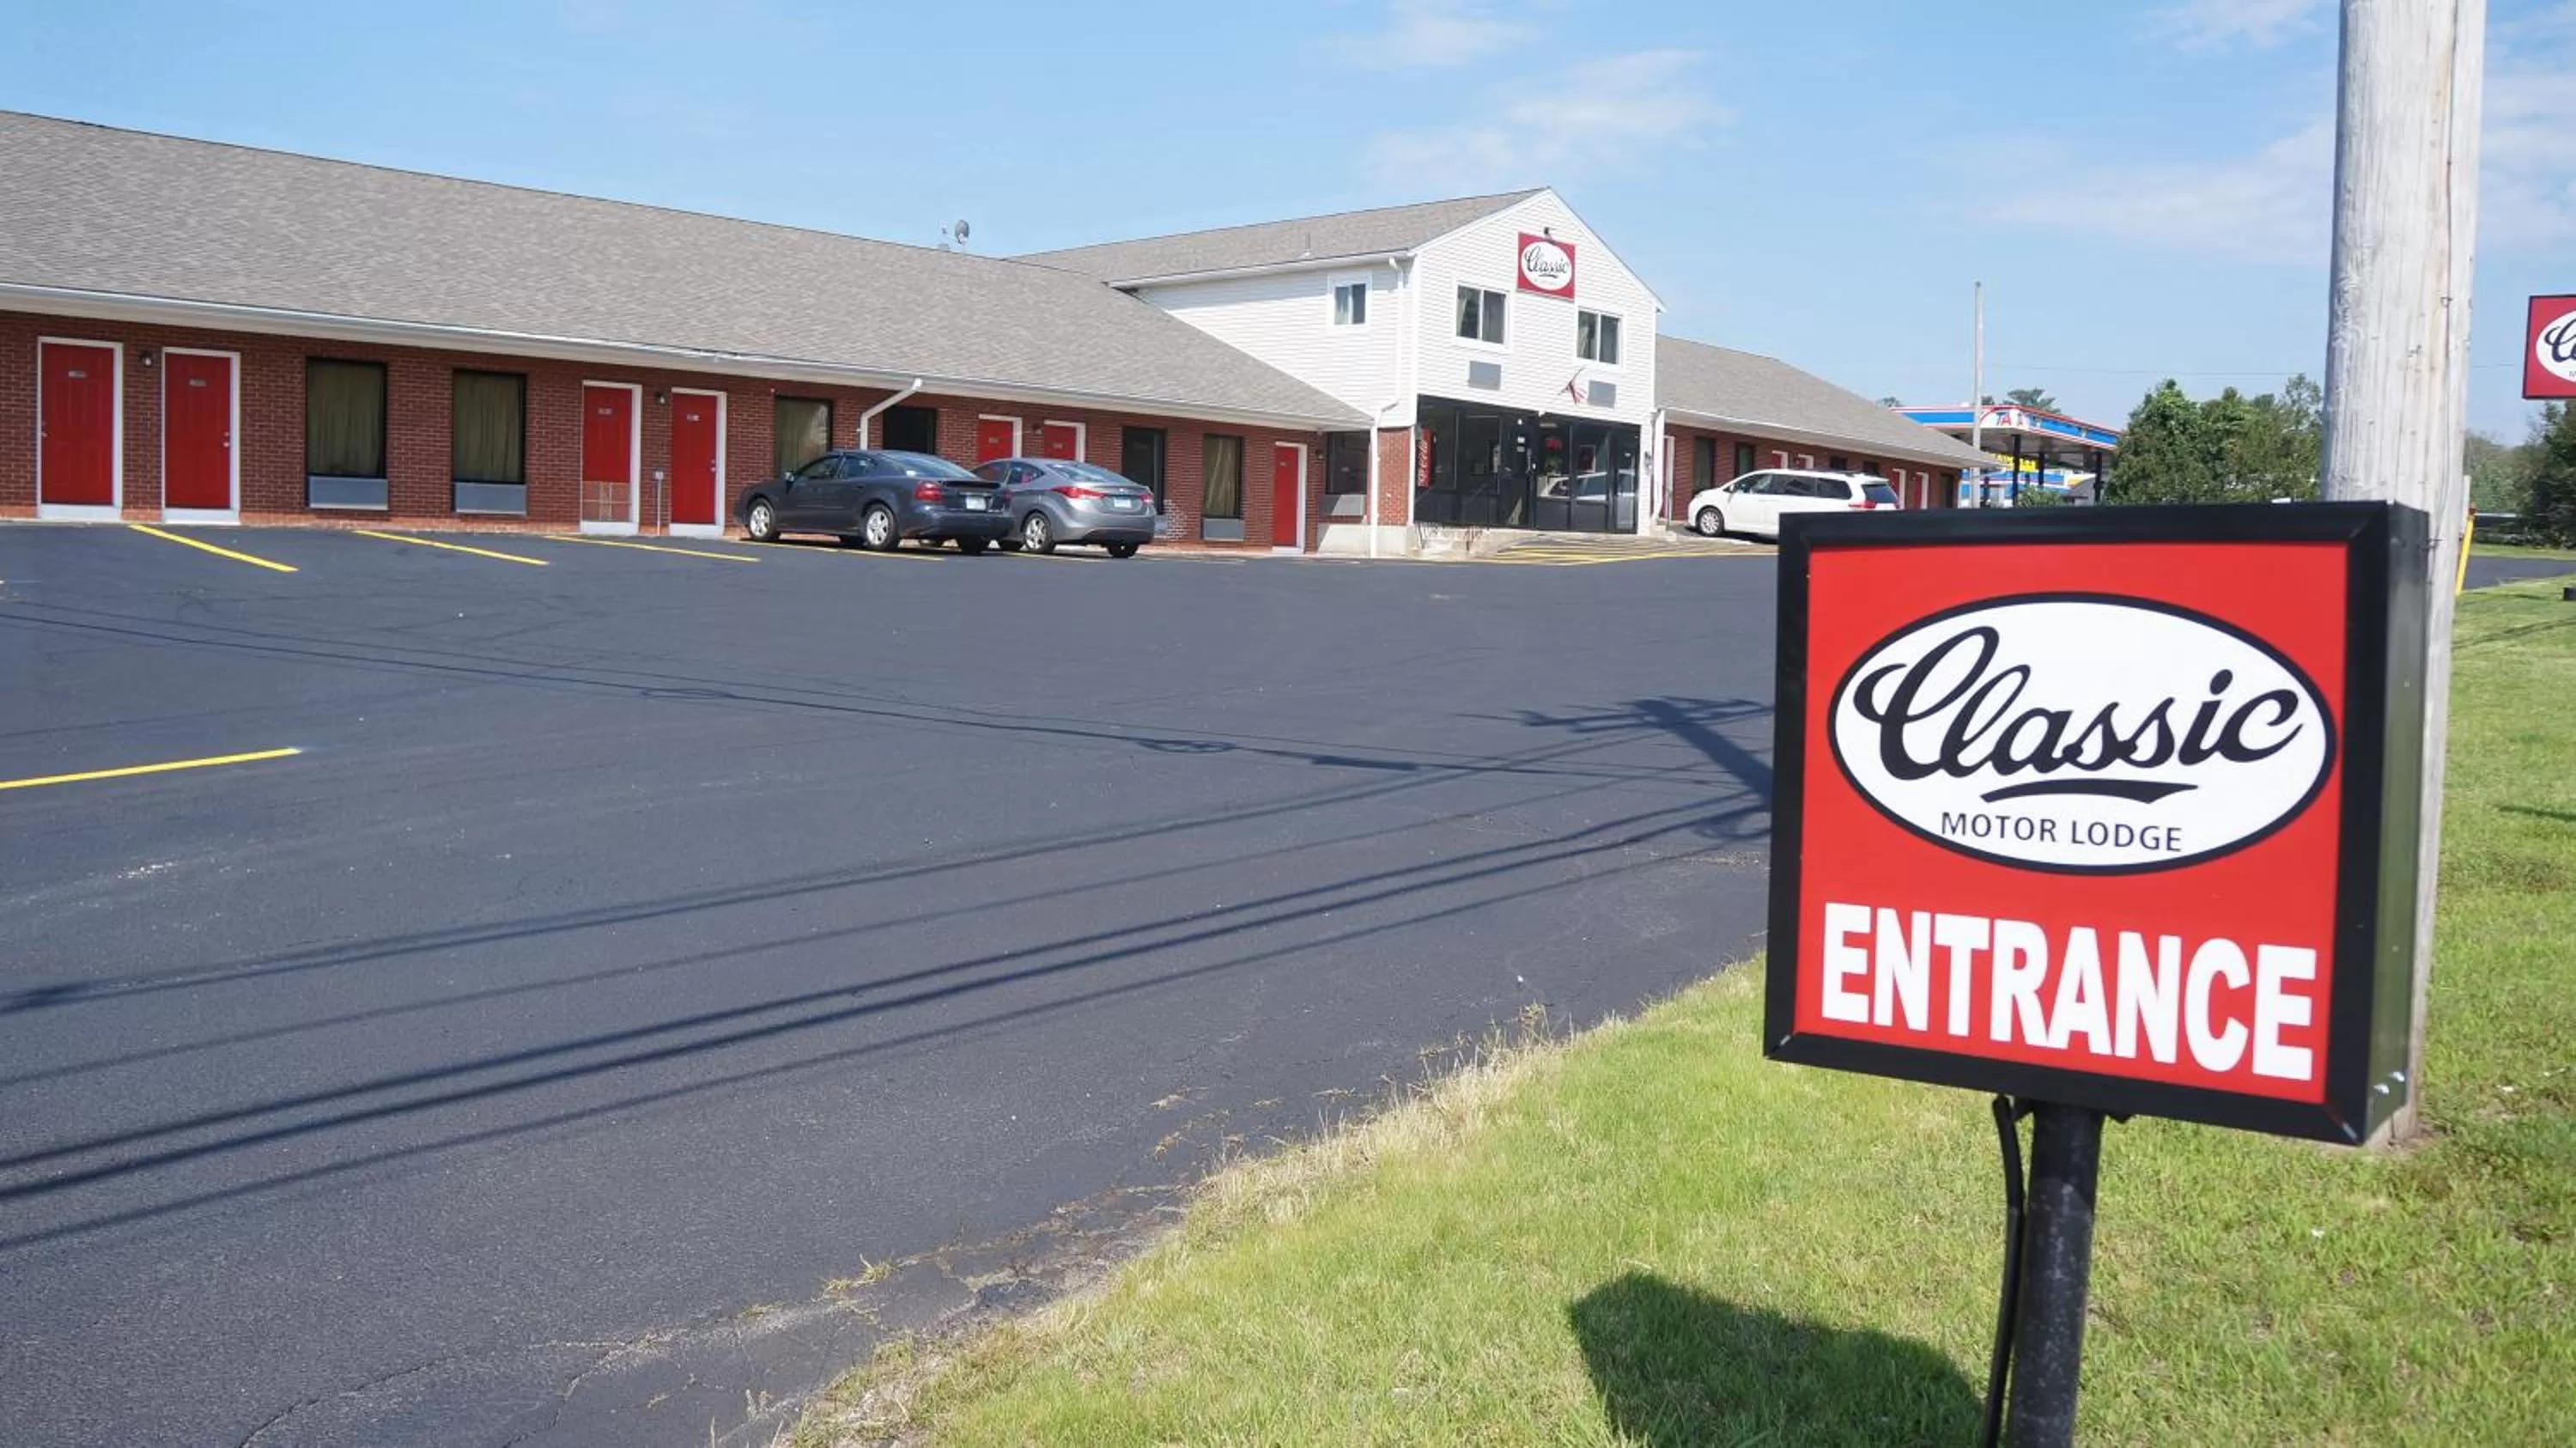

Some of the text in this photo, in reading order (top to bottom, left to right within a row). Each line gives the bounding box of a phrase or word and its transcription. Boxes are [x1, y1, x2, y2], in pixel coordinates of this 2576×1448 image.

[1524, 245, 1570, 273] Classic
[1853, 626, 2303, 780] Classic
[1941, 812, 2182, 852] MOTOR LODGE
[1821, 902, 2317, 1081] ENTRANCE
